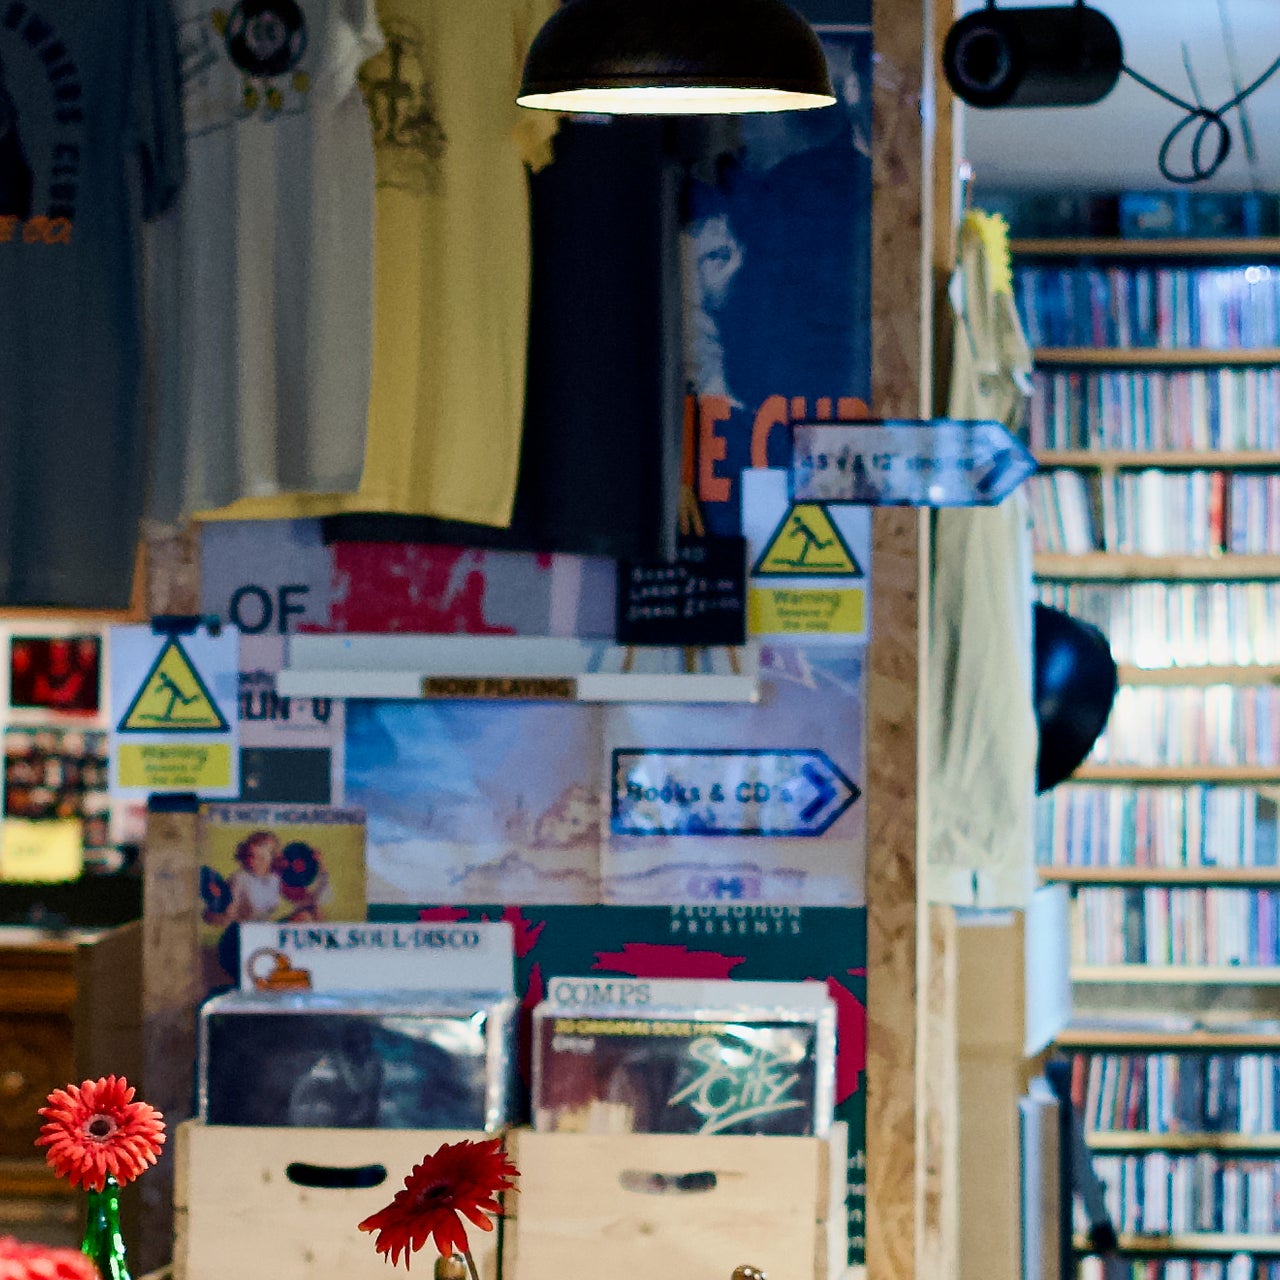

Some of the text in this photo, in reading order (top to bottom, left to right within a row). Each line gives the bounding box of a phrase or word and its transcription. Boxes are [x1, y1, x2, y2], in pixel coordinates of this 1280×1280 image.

[229, 584, 309, 635] OF
[773, 591, 841, 608] Warning
[485, 678, 570, 697] PLAYING
[141, 744, 208, 764] Warning
[626, 780, 700, 804] Books
[709, 782, 725, 803] &
[671, 919, 801, 935] PRESENTS
[554, 982, 651, 1005] COMPS
